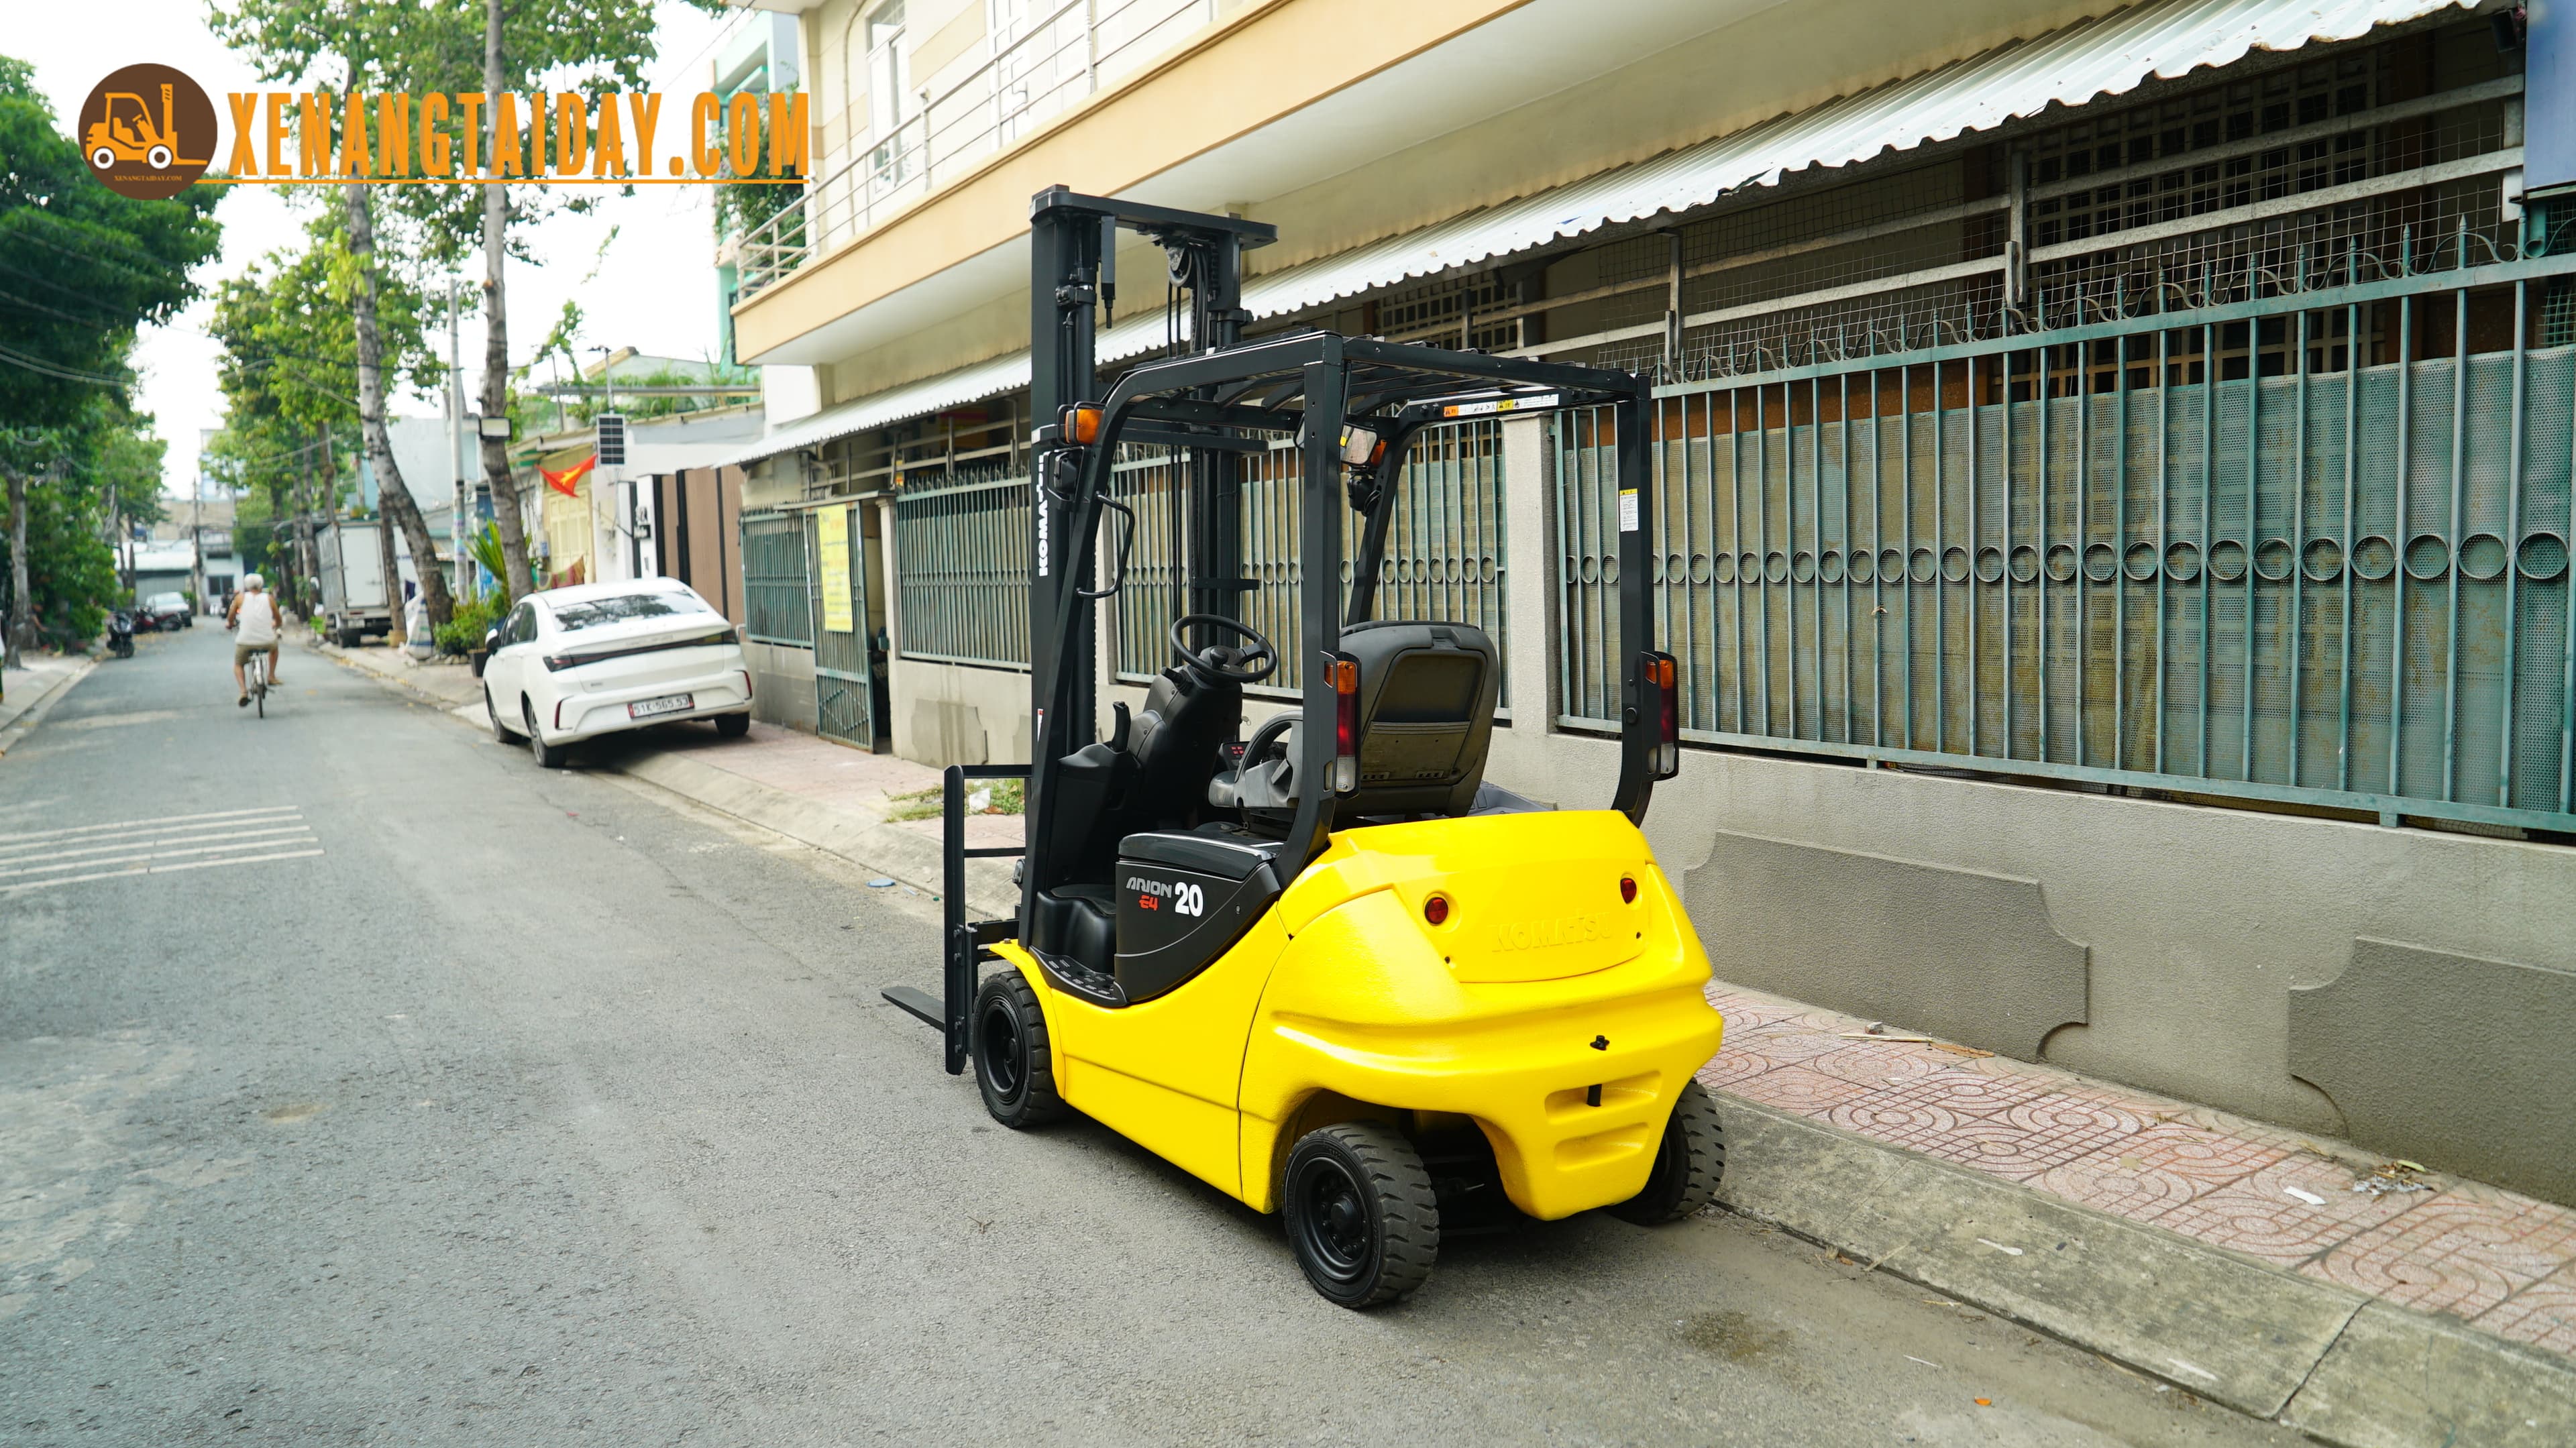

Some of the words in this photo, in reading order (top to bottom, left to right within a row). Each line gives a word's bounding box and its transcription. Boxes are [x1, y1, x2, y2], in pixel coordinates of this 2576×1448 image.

[1126, 877, 1173, 899] ARION
[1175, 881, 1203, 917] 20
[1138, 895, 1159, 911] E4
[1487, 908, 1613, 953] KOMATSU
